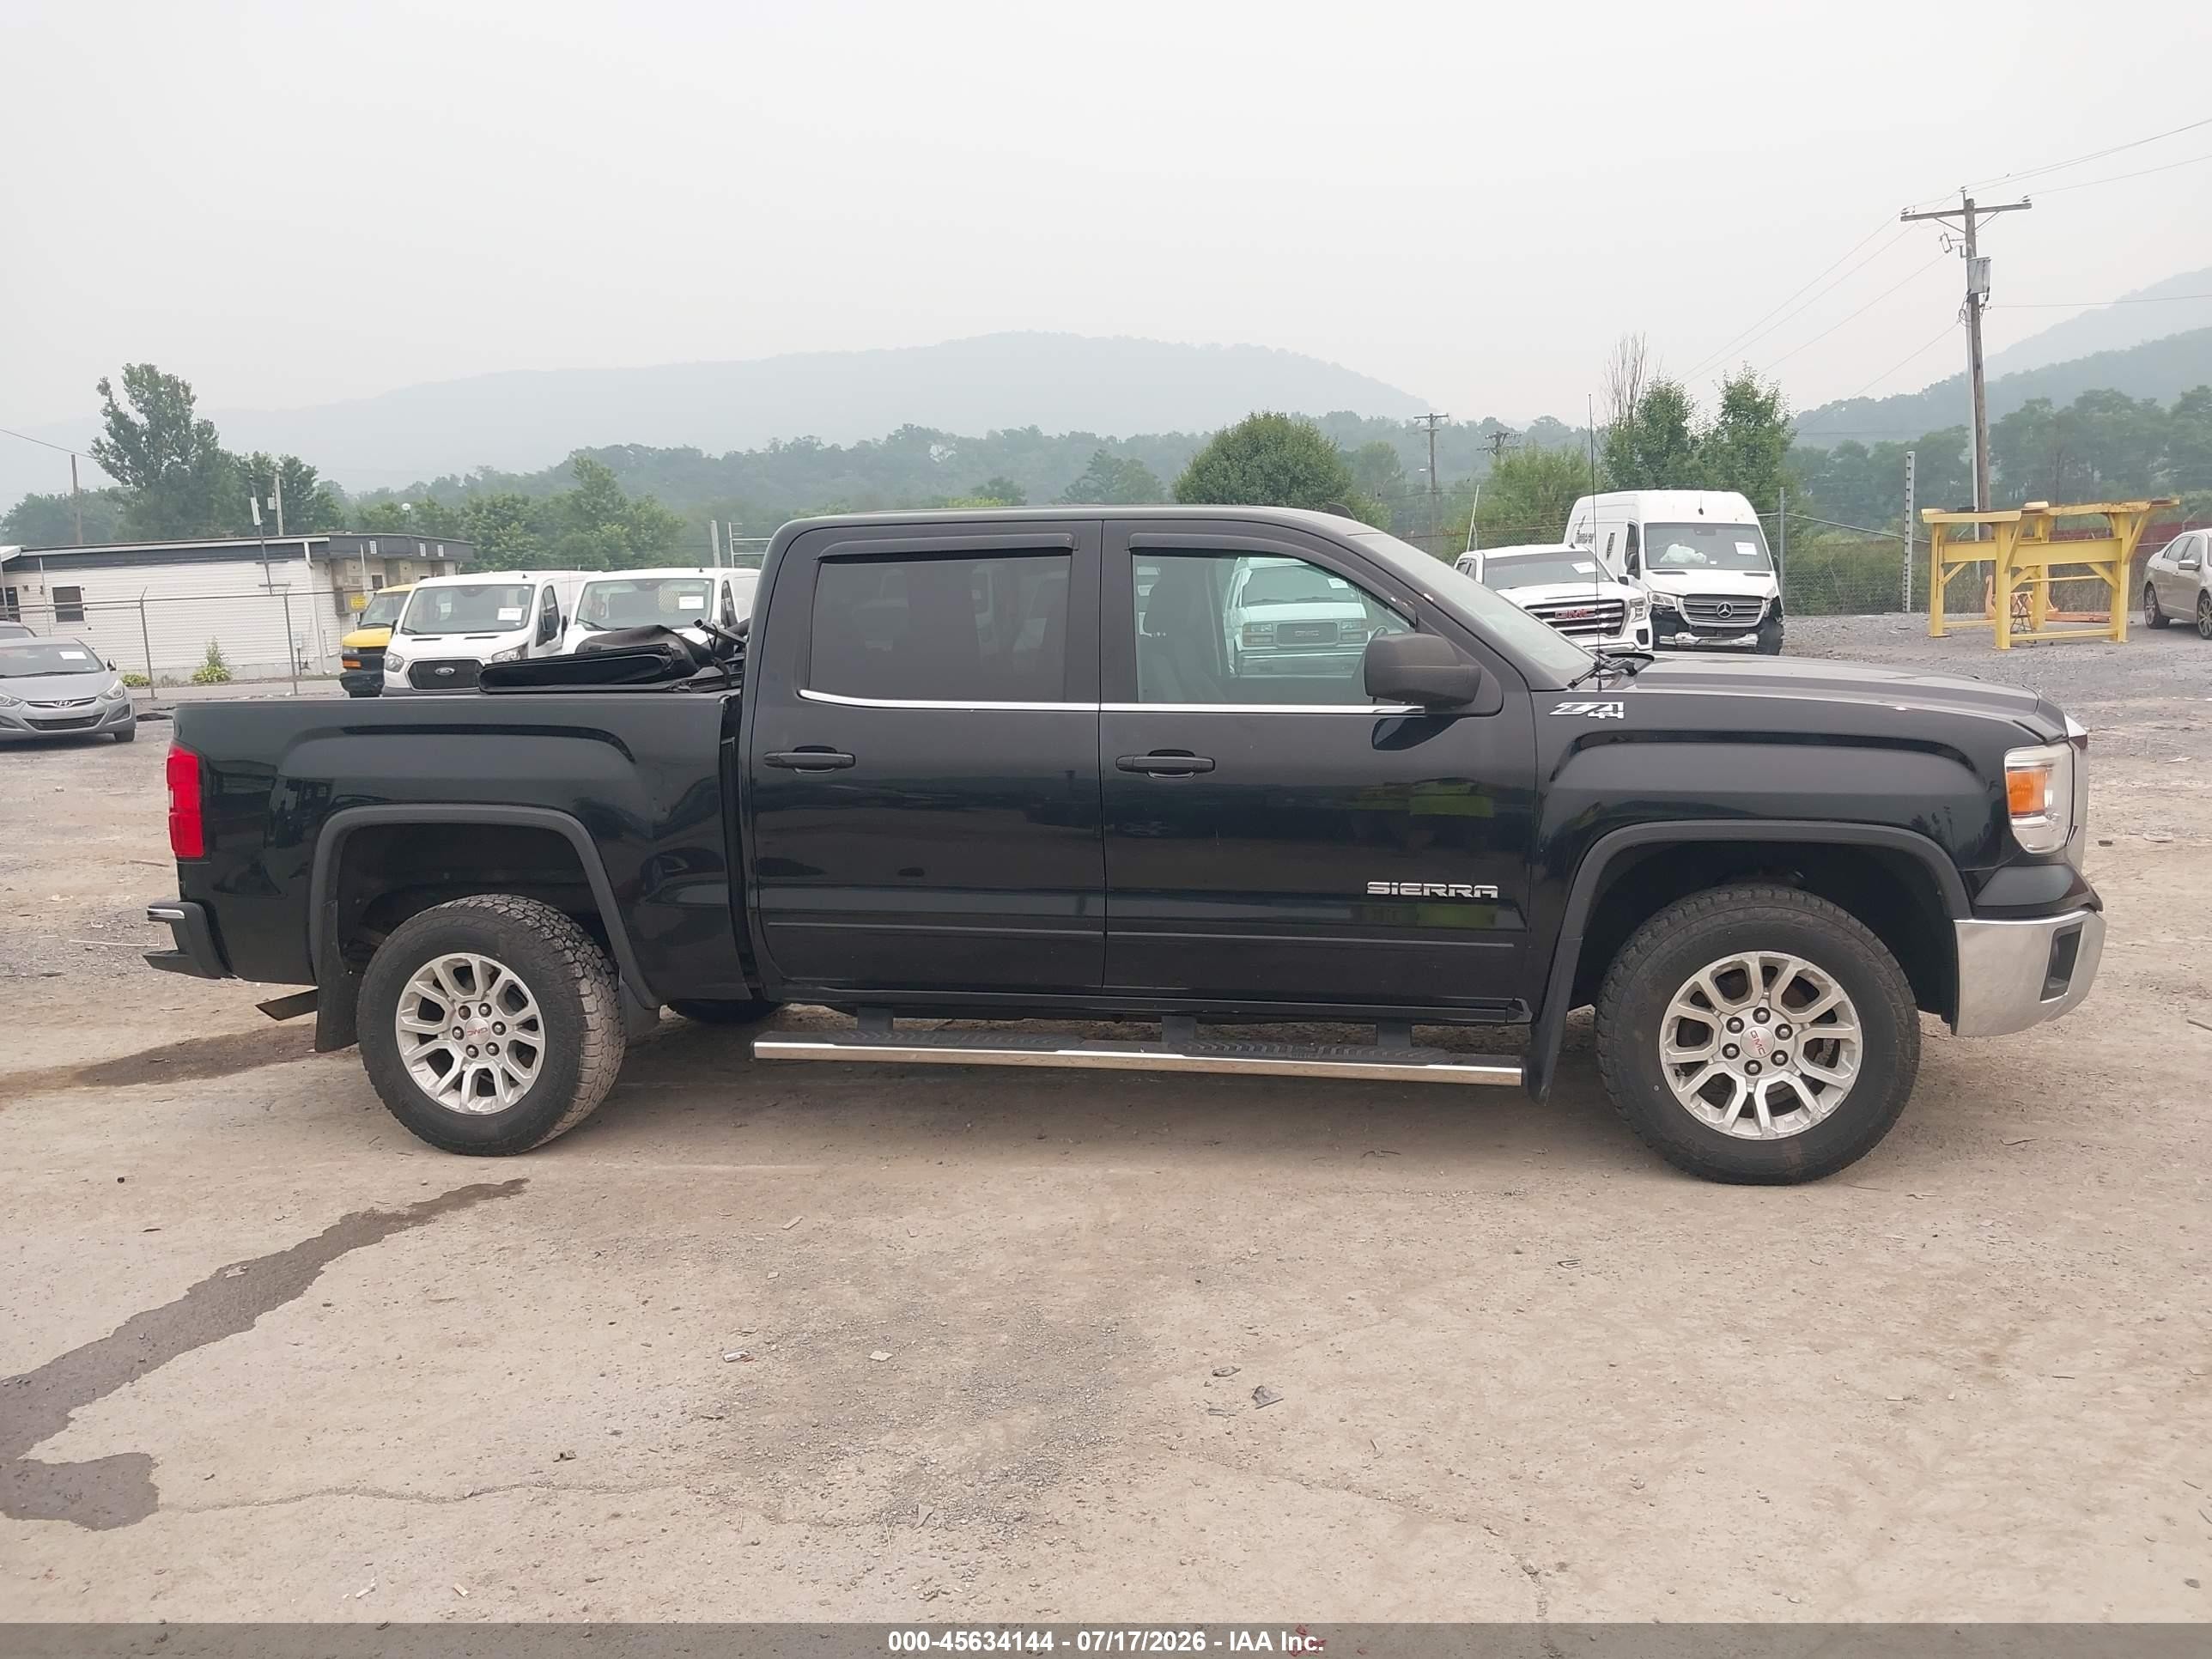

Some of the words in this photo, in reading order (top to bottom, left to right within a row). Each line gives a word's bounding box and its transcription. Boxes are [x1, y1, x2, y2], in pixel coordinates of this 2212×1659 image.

[1555, 608, 1595, 619] GMC
[1367, 881, 1498, 898] SIERRA
[466, 1027, 488, 1036] GMC
[1750, 1030, 1766, 1055] GMC
